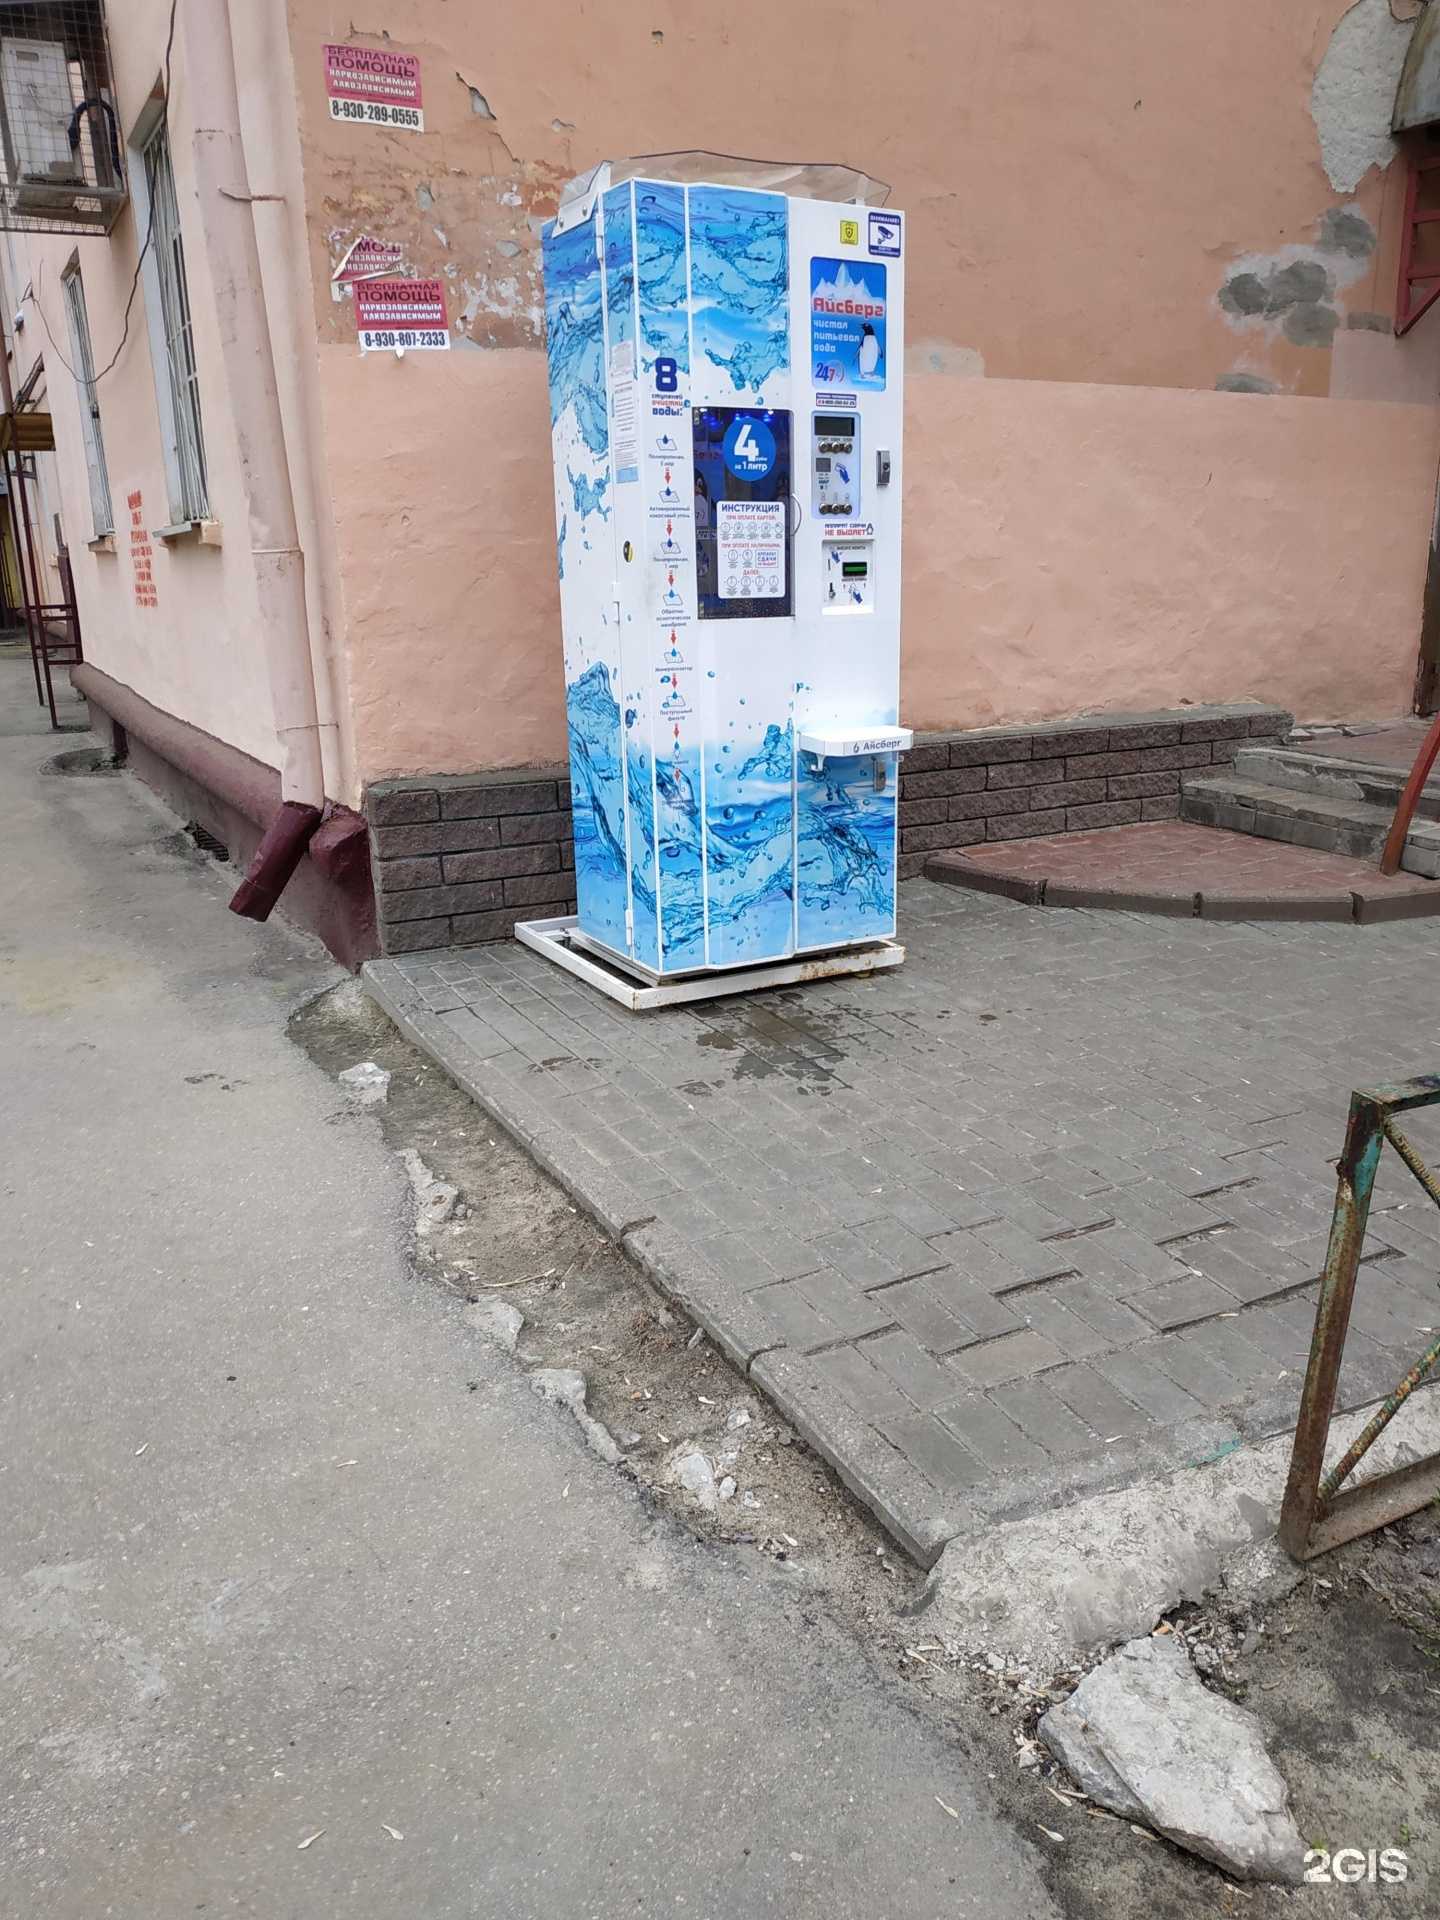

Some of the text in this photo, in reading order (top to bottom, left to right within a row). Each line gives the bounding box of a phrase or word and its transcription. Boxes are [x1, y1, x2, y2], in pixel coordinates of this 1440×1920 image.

[327, 46, 415, 65] БЕСПЛАТНАЯ
[328, 56, 415, 78] ПОМОЩЬ
[329, 68, 417, 88] НАРКОЗАВИСИМЫМ
[332, 100, 419, 126] 8-930-289-0555
[357, 283, 440, 291] БЕСПЛАТНАЯ
[357, 291, 441, 303] ПОМОЩЬ
[360, 303, 442, 312] НАРКОЗАВИСИМЫМ
[813, 297, 884, 318] Айсберг
[365, 331, 446, 347] 8-930-807-2333
[814, 332, 860, 342] питьевая
[814, 343, 836, 352] вода
[655, 357, 678, 392] 8
[652, 407, 683, 416] воды:
[734, 424, 759, 462] 4
[742, 461, 747, 469] 1
[747, 463, 768, 472] литр
[721, 503, 780, 513] ИНСТРУКЦИЯ
[863, 740, 903, 751] Айсберг
